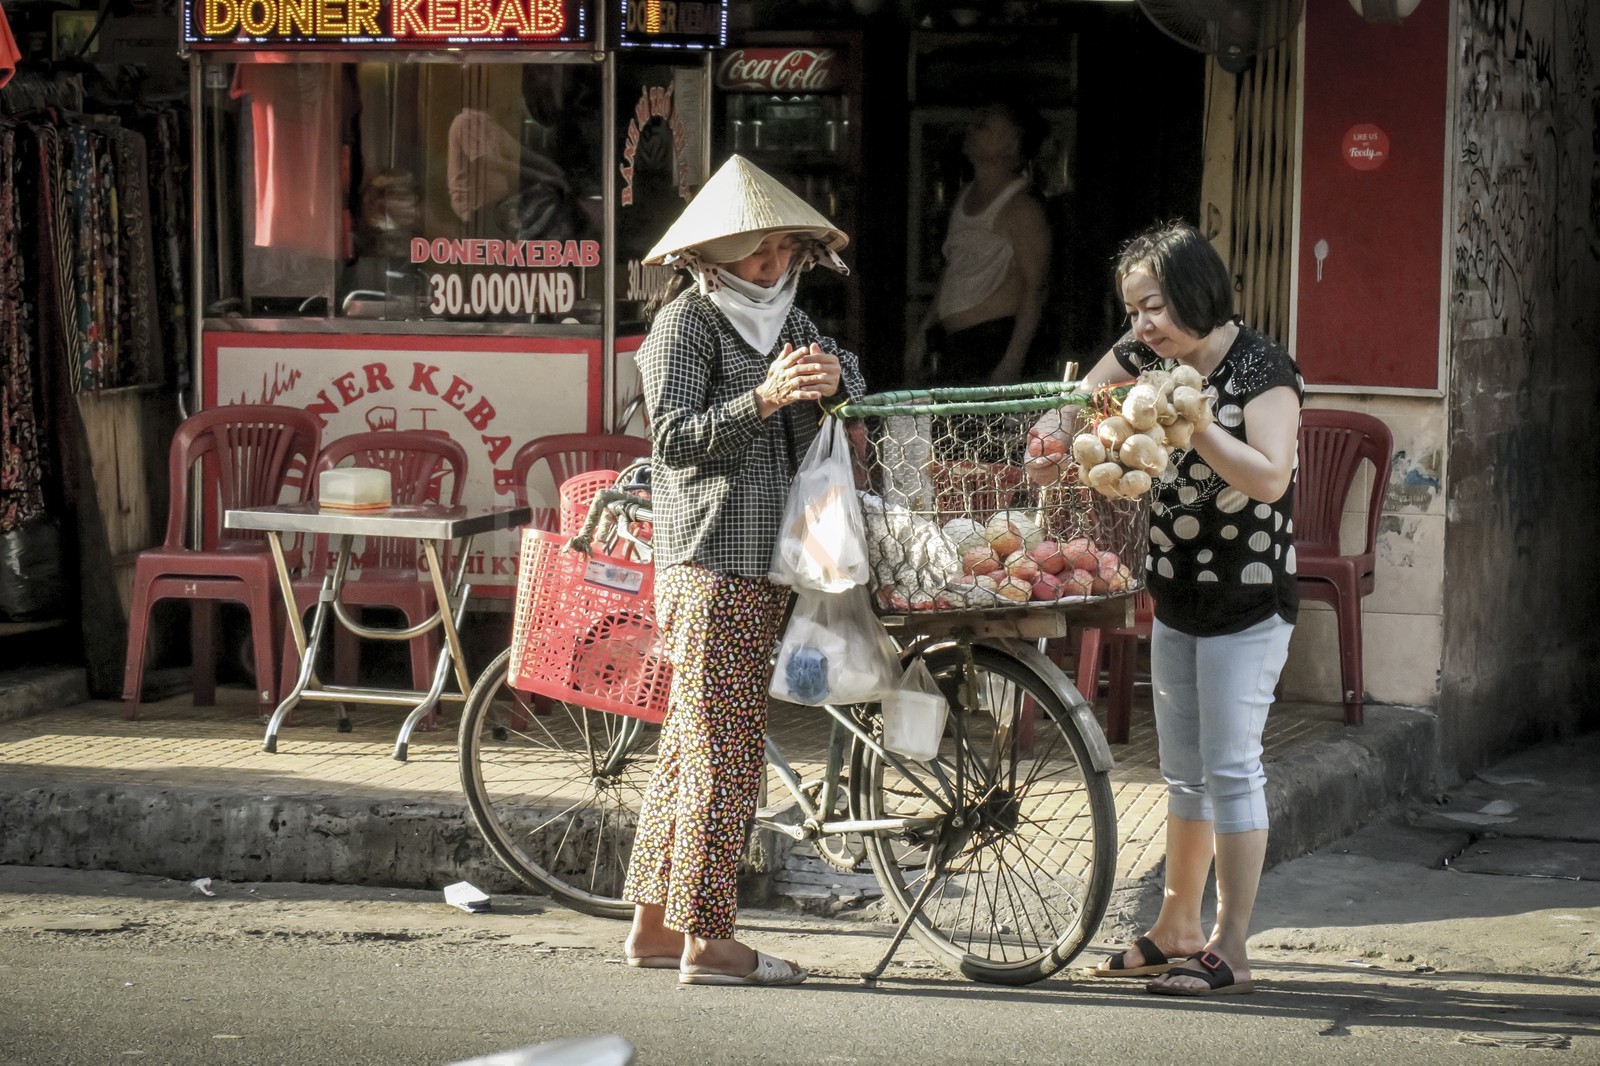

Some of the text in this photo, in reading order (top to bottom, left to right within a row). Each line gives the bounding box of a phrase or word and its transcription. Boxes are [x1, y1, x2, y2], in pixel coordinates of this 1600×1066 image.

[205, 0, 565, 36] DONER KEBAB
[1353, 133, 1378, 141] LIKE US
[429, 272, 575, 315] 30.000VNĐ
[409, 362, 516, 496] KEBAB
